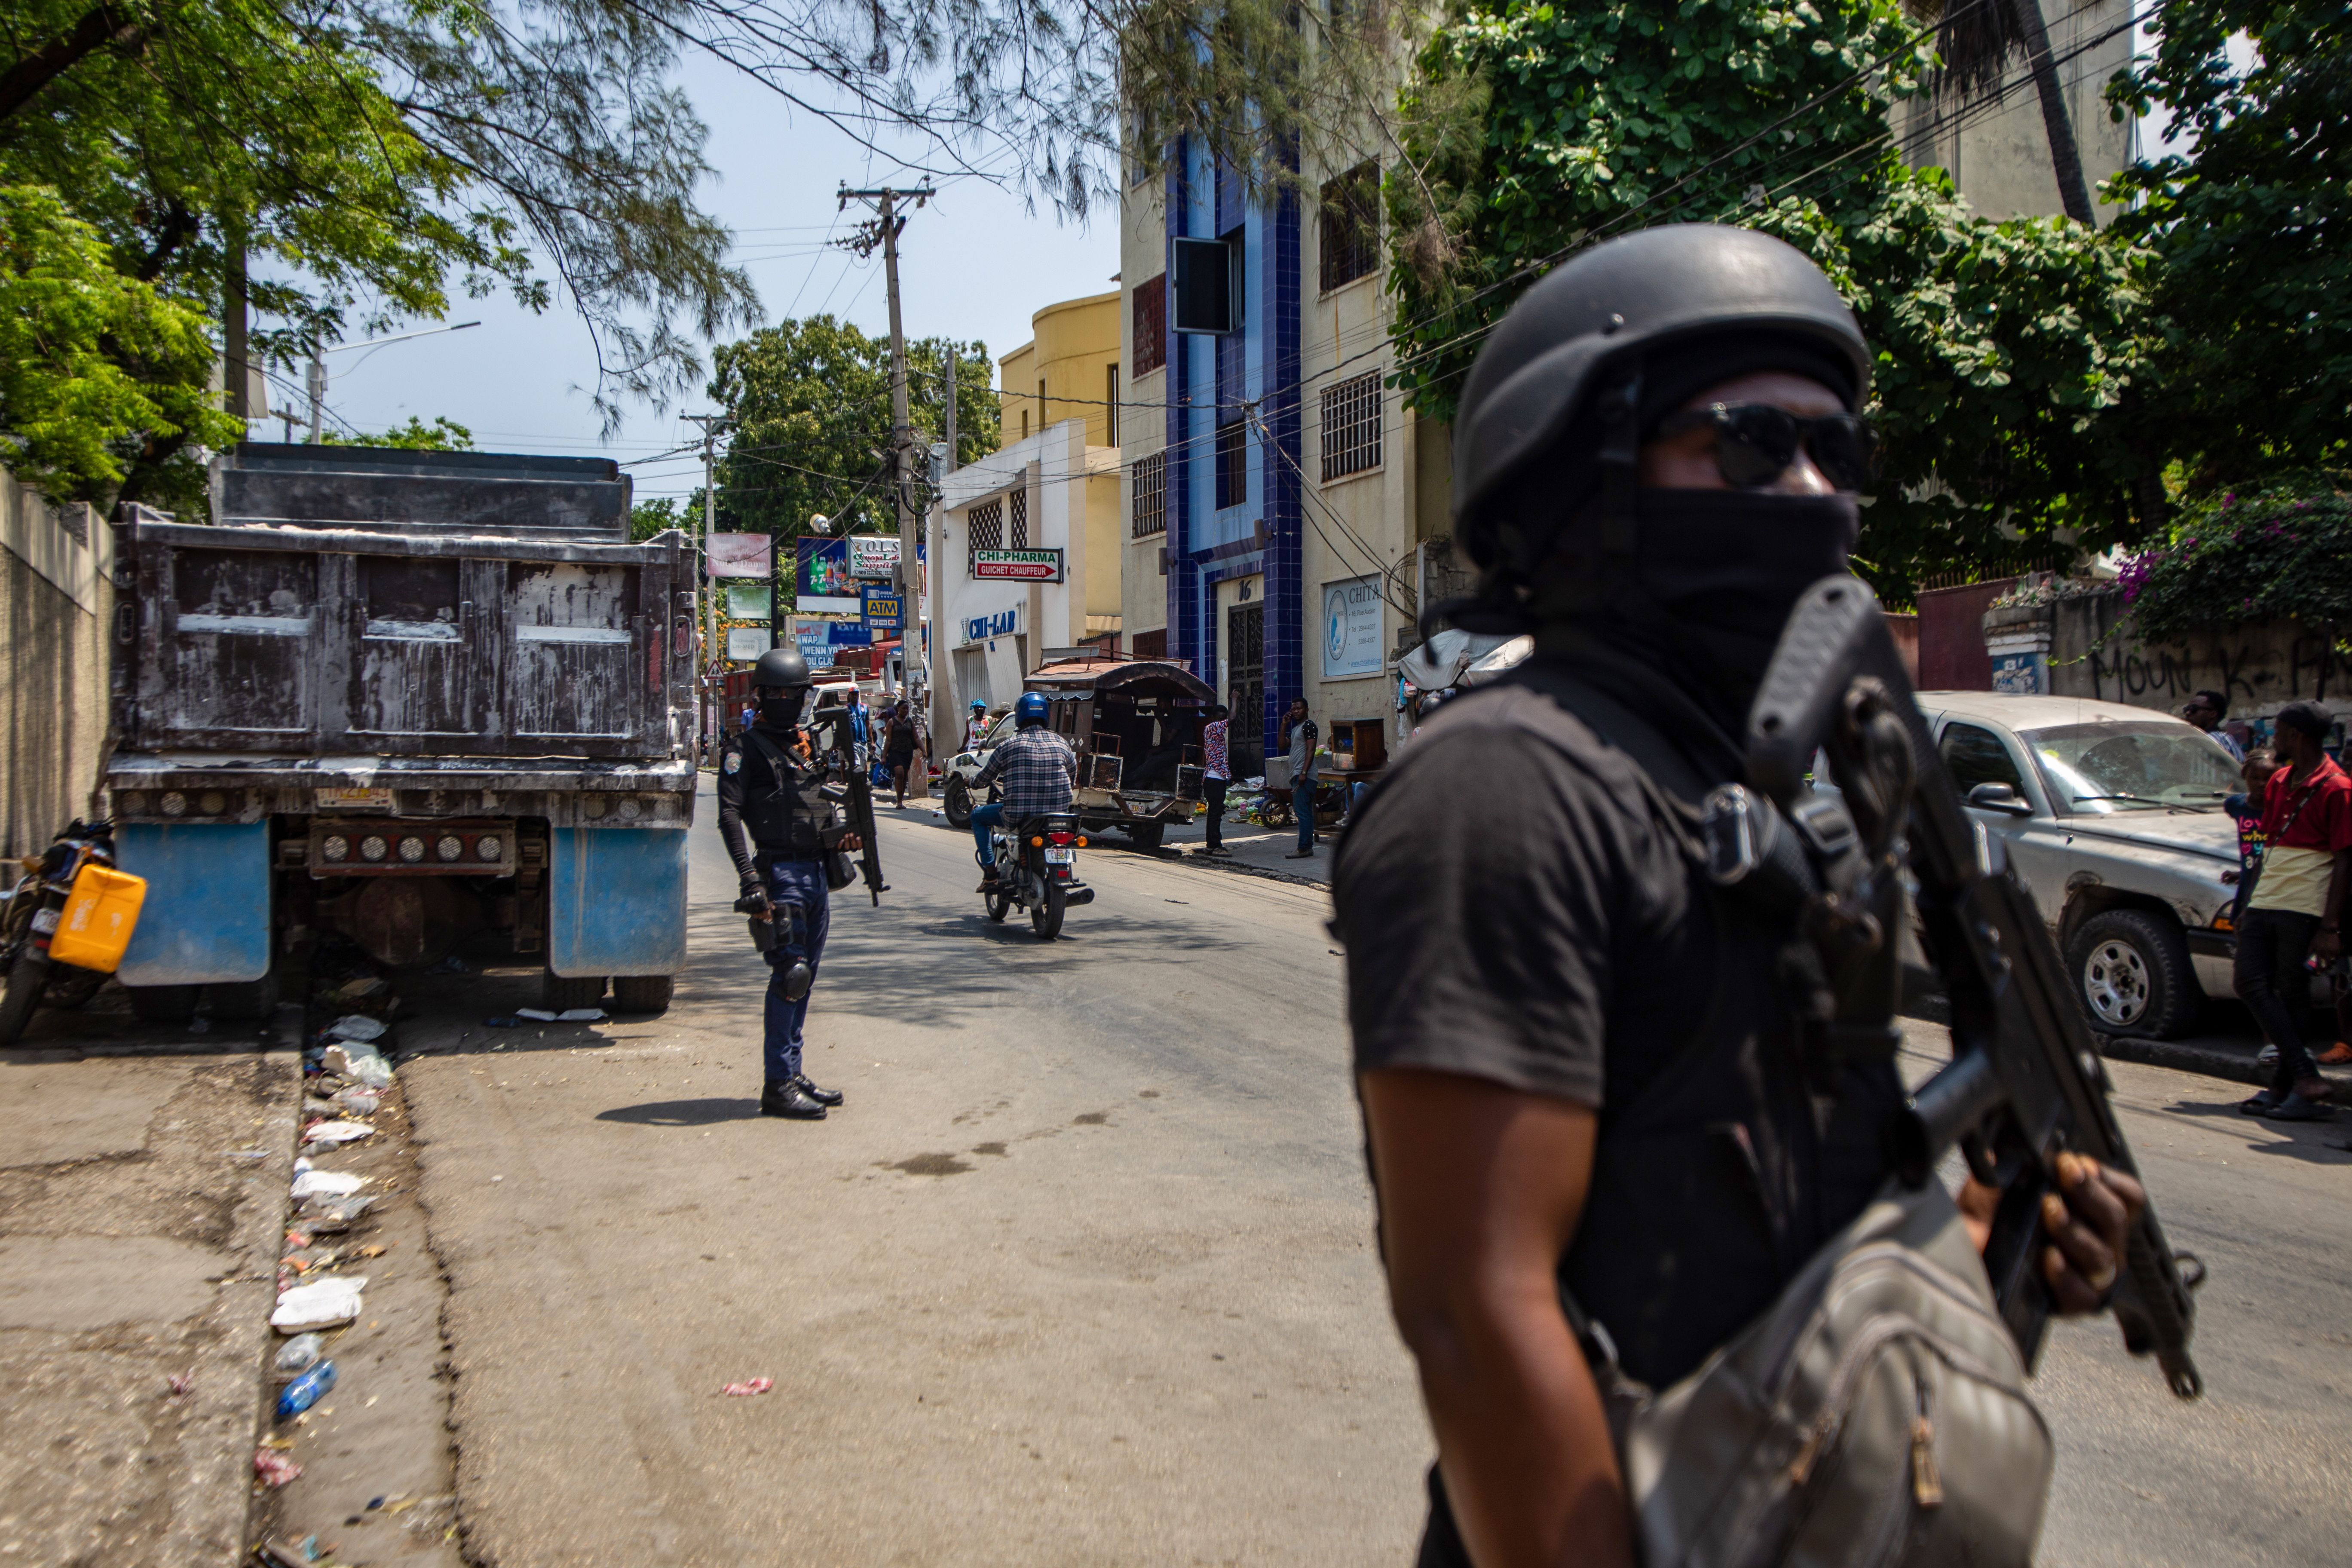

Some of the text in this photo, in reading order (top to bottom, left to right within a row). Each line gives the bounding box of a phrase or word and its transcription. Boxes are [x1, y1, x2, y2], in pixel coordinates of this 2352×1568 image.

[866, 541, 899, 552] O.L.S
[978, 551, 1056, 563] CHI-PHARMA
[981, 565, 1046, 576] GUICHET CHAUFFEUR
[869, 602, 897, 614] ATM
[969, 610, 1015, 640] CHI-LAB
[801, 635, 818, 644] WAP
[801, 646, 827, 656] JWENN
[2092, 646, 2191, 704] MOUN
